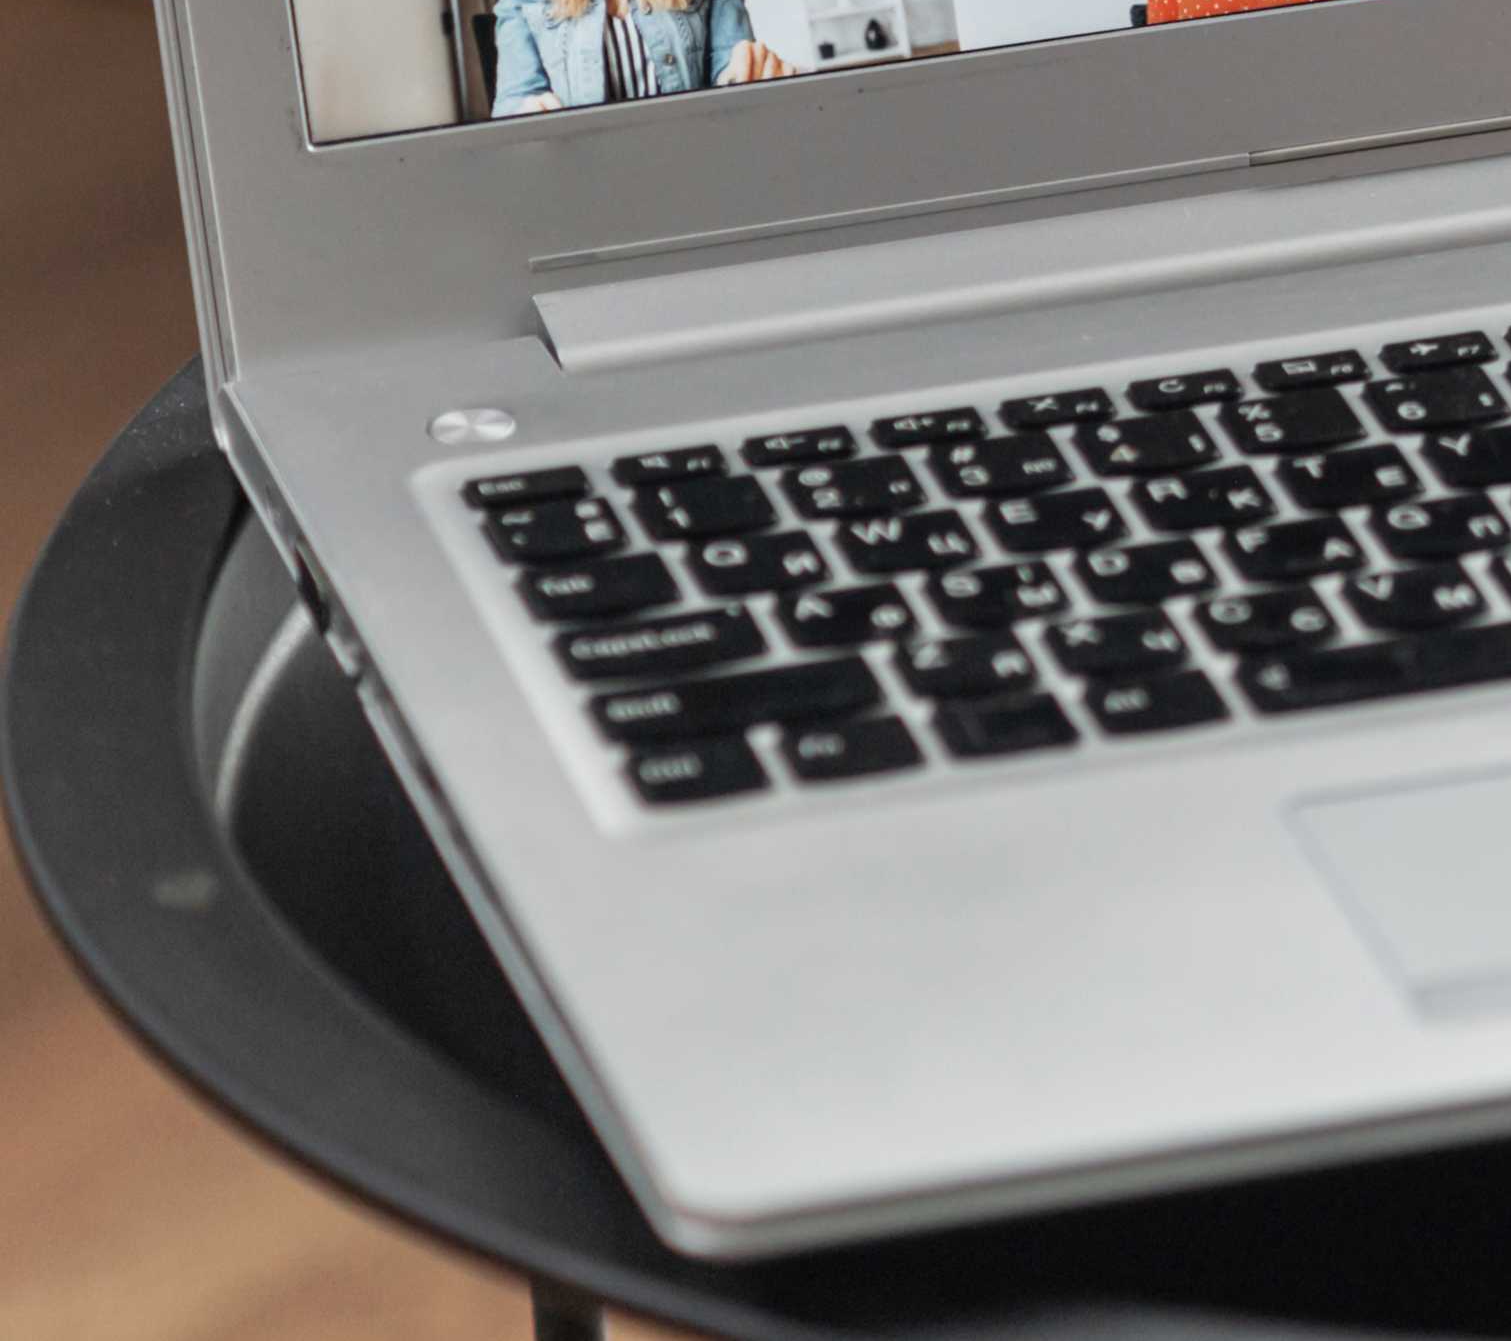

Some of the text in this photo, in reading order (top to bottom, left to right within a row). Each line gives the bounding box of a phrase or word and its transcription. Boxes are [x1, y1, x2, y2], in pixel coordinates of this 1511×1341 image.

[1438, 433, 1472, 457] Y
[1292, 454, 1325, 479] T
[1145, 477, 1188, 503] R
[998, 498, 1037, 525] E
[850, 518, 901, 545] W
[1356, 572, 1395, 601] V
